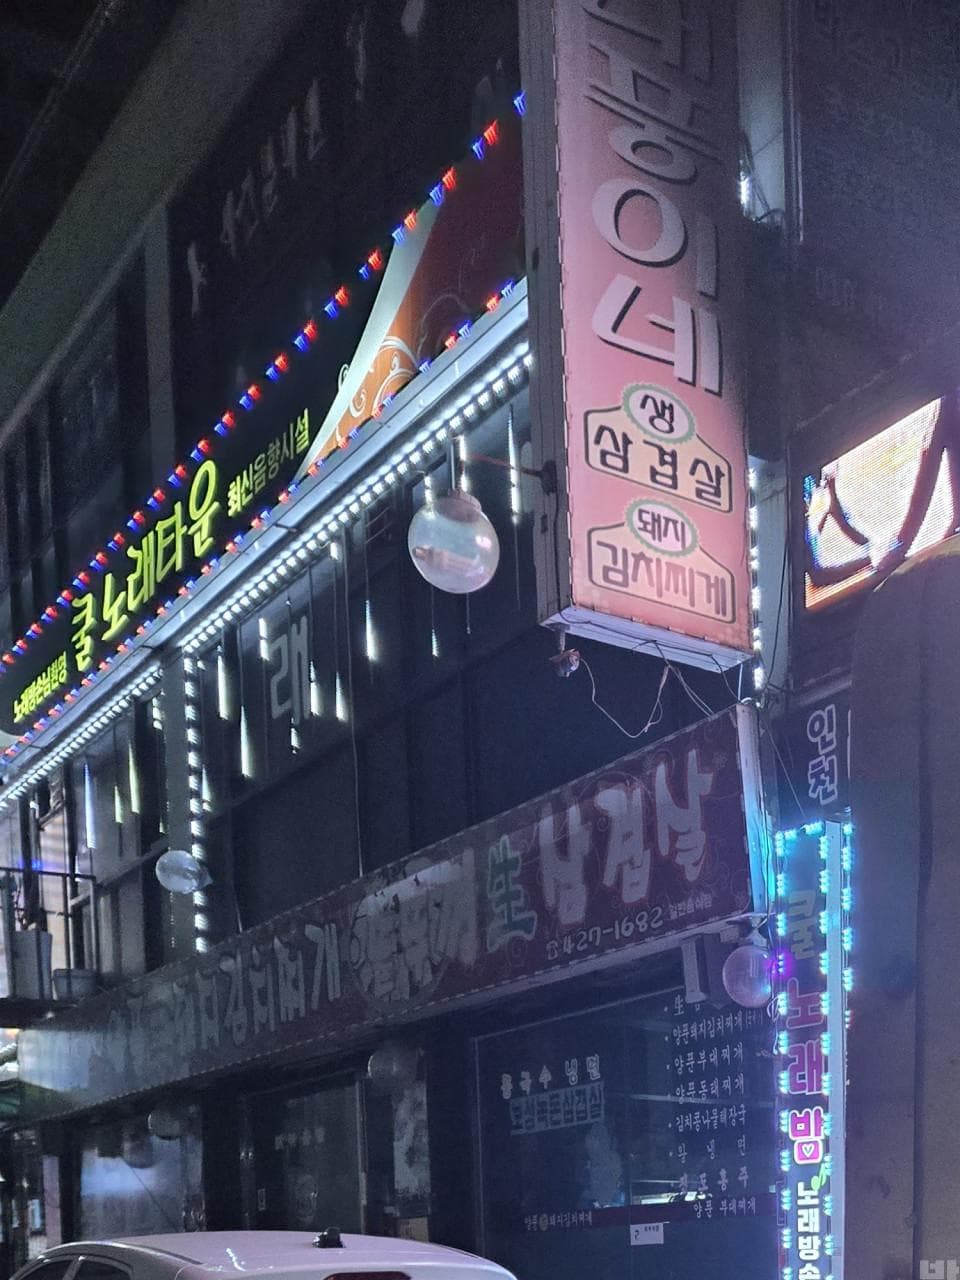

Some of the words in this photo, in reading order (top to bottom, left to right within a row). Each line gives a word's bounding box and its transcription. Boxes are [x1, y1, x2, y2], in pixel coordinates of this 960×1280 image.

[640, 394, 675, 434] 생
[227, 407, 310, 518] 최신음향시설
[593, 425, 726, 506] 삼겹살
[638, 507, 687, 551] 돼지
[806, 703, 838, 806] 인천
